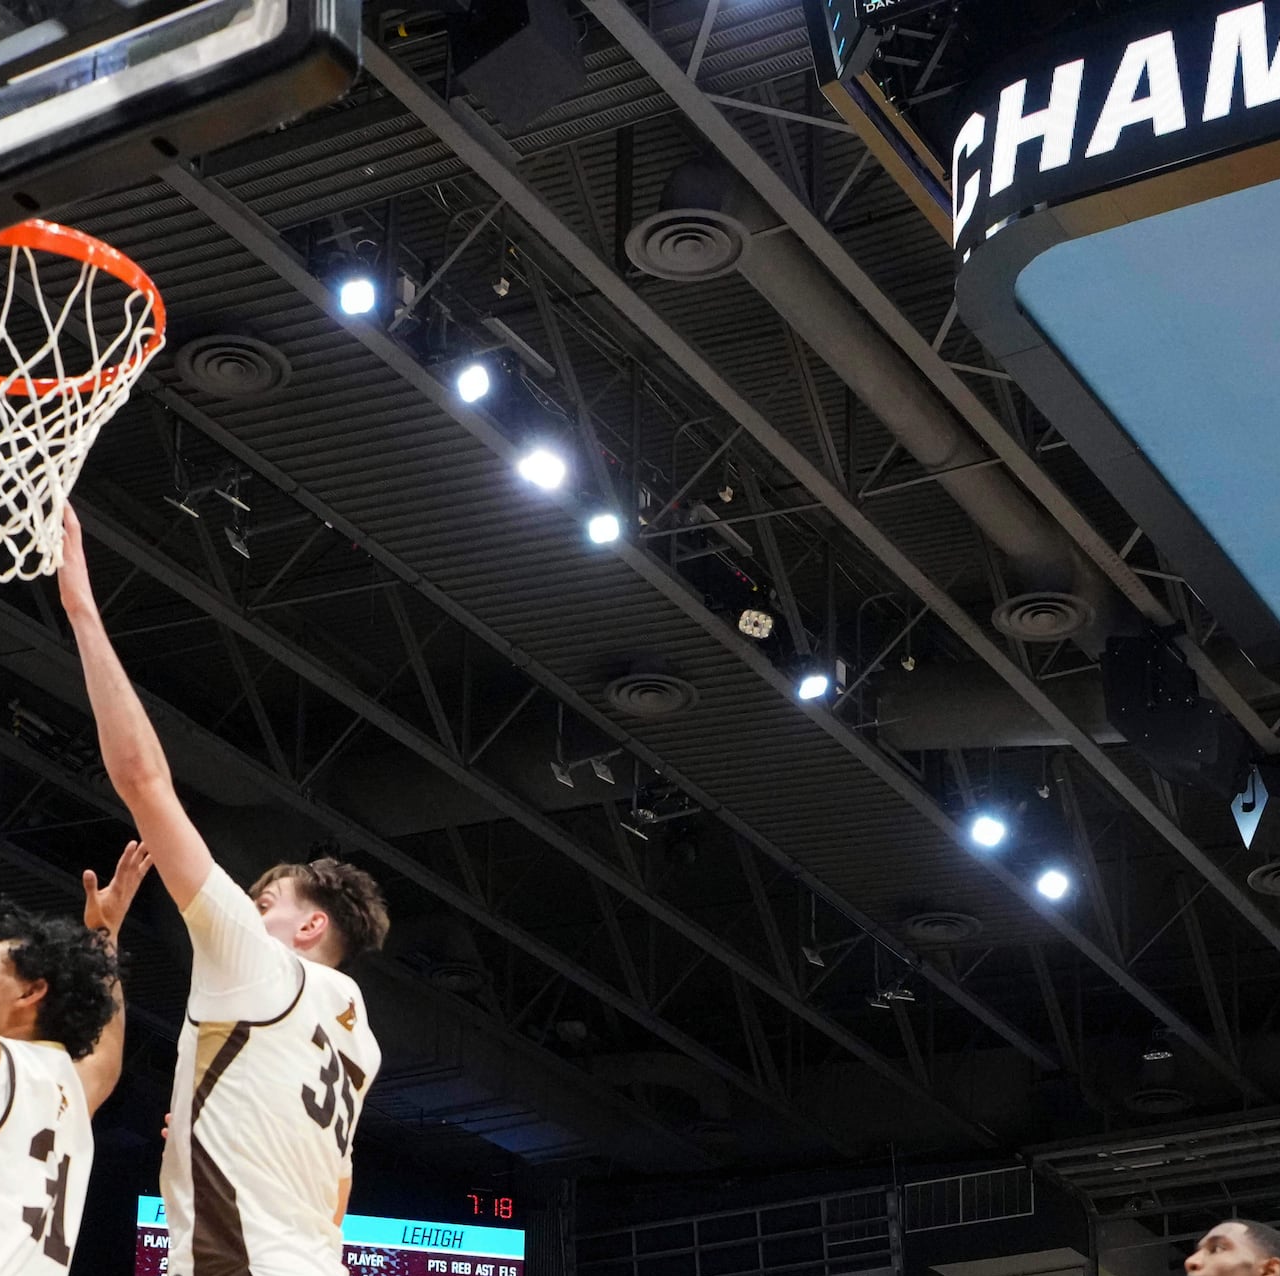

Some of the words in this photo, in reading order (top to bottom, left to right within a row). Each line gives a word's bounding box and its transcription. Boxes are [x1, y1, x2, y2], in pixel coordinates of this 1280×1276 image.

[301, 1023, 367, 1158] 35
[22, 1127, 71, 1267] 31
[466, 1194, 513, 1219] 7:18
[143, 1234, 172, 1249] PLAYE
[401, 1226, 464, 1249] LEHIGH
[347, 1252, 384, 1267] PLAYER
[427, 1259, 447, 1273] PTS
[451, 1261, 471, 1275] REB
[475, 1263, 495, 1276] AST
